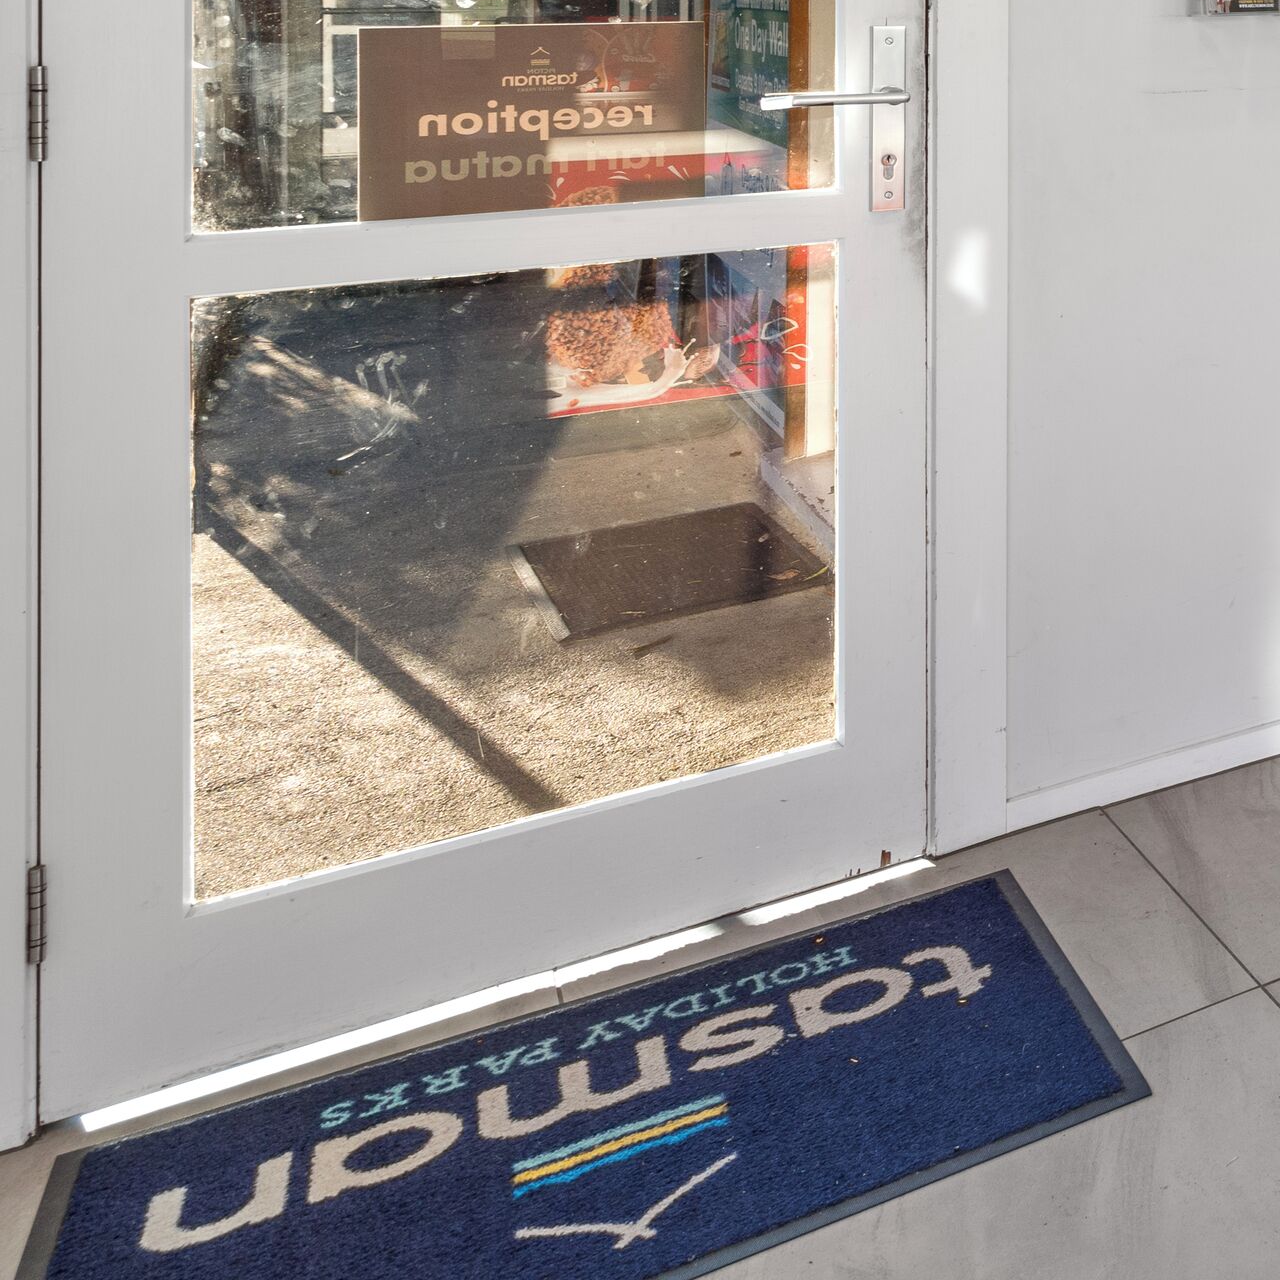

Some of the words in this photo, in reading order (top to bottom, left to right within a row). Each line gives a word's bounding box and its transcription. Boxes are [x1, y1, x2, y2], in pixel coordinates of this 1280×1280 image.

[735, 17, 749, 50] One
[752, 19, 767, 62] Day
[580, 944, 858, 1063] HOLIDAY
[137, 942, 996, 1253] tasman
[319, 1035, 569, 1131] PARKS
